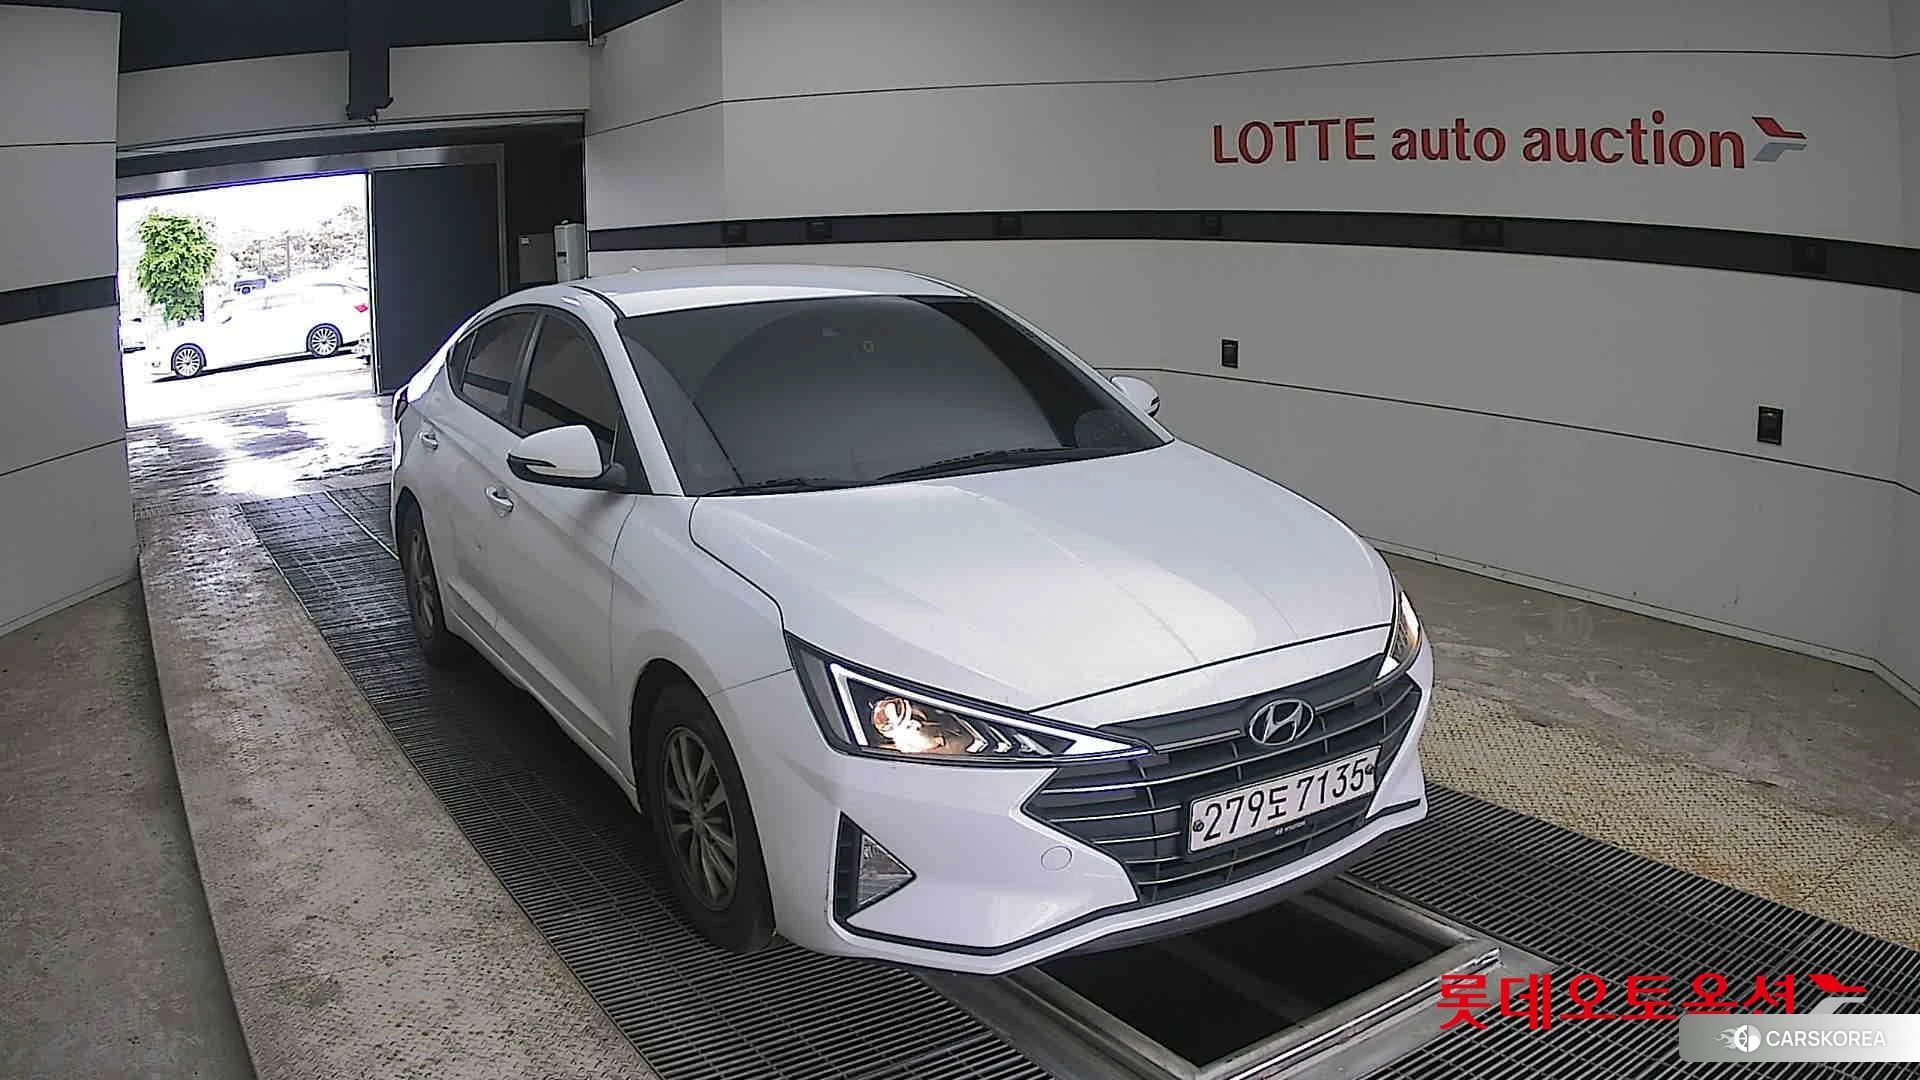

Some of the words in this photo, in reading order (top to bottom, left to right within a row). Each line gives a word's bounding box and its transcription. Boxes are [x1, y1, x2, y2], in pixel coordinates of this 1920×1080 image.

[1213, 117, 1376, 164] LOTTE
[1392, 118, 1506, 162] auto
[1522, 110, 1746, 169] auction
[1296, 757, 1369, 813] 7135
